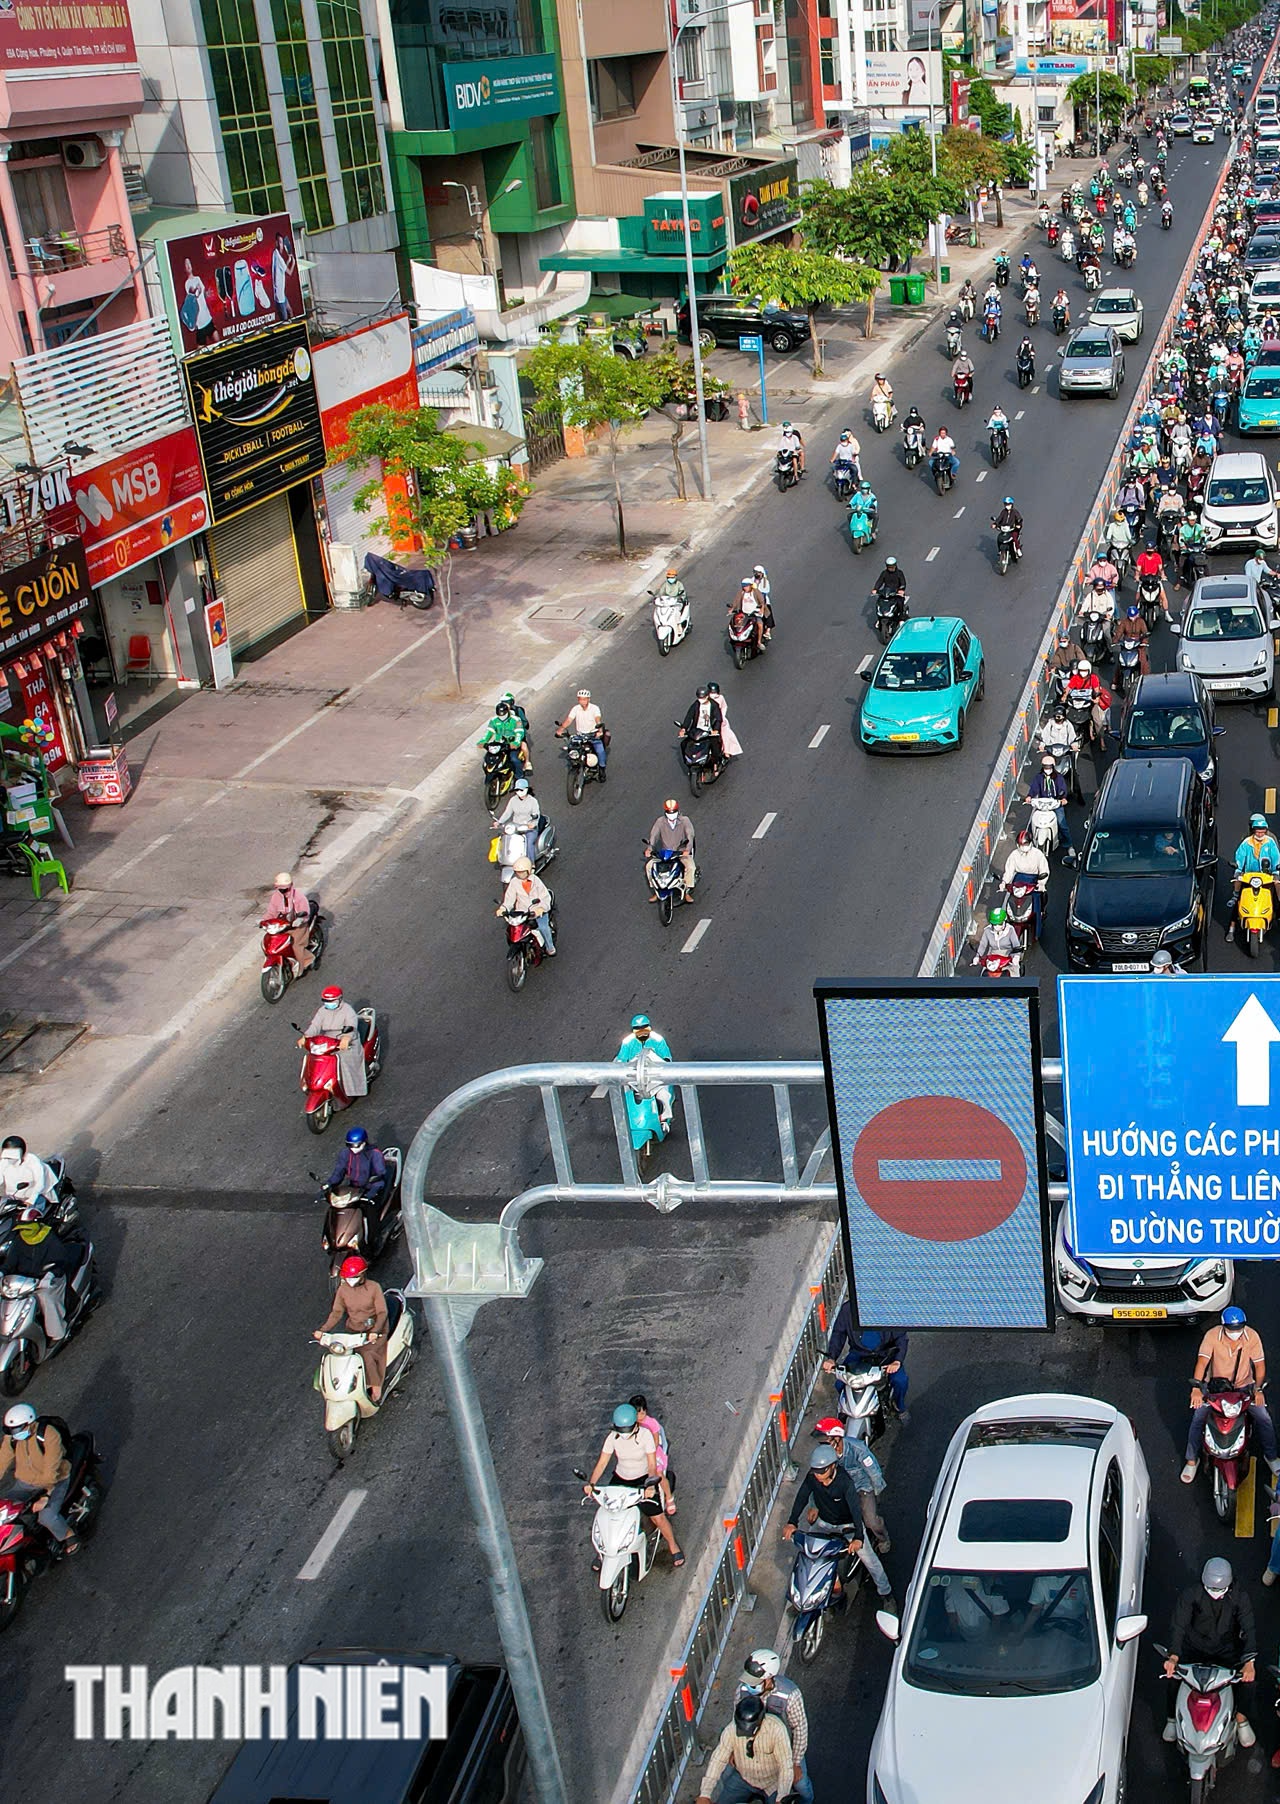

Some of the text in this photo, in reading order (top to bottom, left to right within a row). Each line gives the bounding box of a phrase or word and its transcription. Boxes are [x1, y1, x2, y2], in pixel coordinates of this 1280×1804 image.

[455, 81, 481, 109] BIDV
[223, 438, 264, 463] PICKLEBALL
[271, 420, 305, 442] FOOTBALL
[25, 468, 73, 519] 79K
[112, 461, 160, 512] MSB
[16, 554, 80, 616] CUỐN
[34, 701, 49, 718] GA
[1083, 1121, 1177, 1157] HƯỚNG
[1184, 1122, 1238, 1157] CÁC
[1098, 1174, 1124, 1201] ĐI
[1130, 1161, 1222, 1201] THẲNG
[1110, 1211, 1203, 1244] ĐƯỜNG
